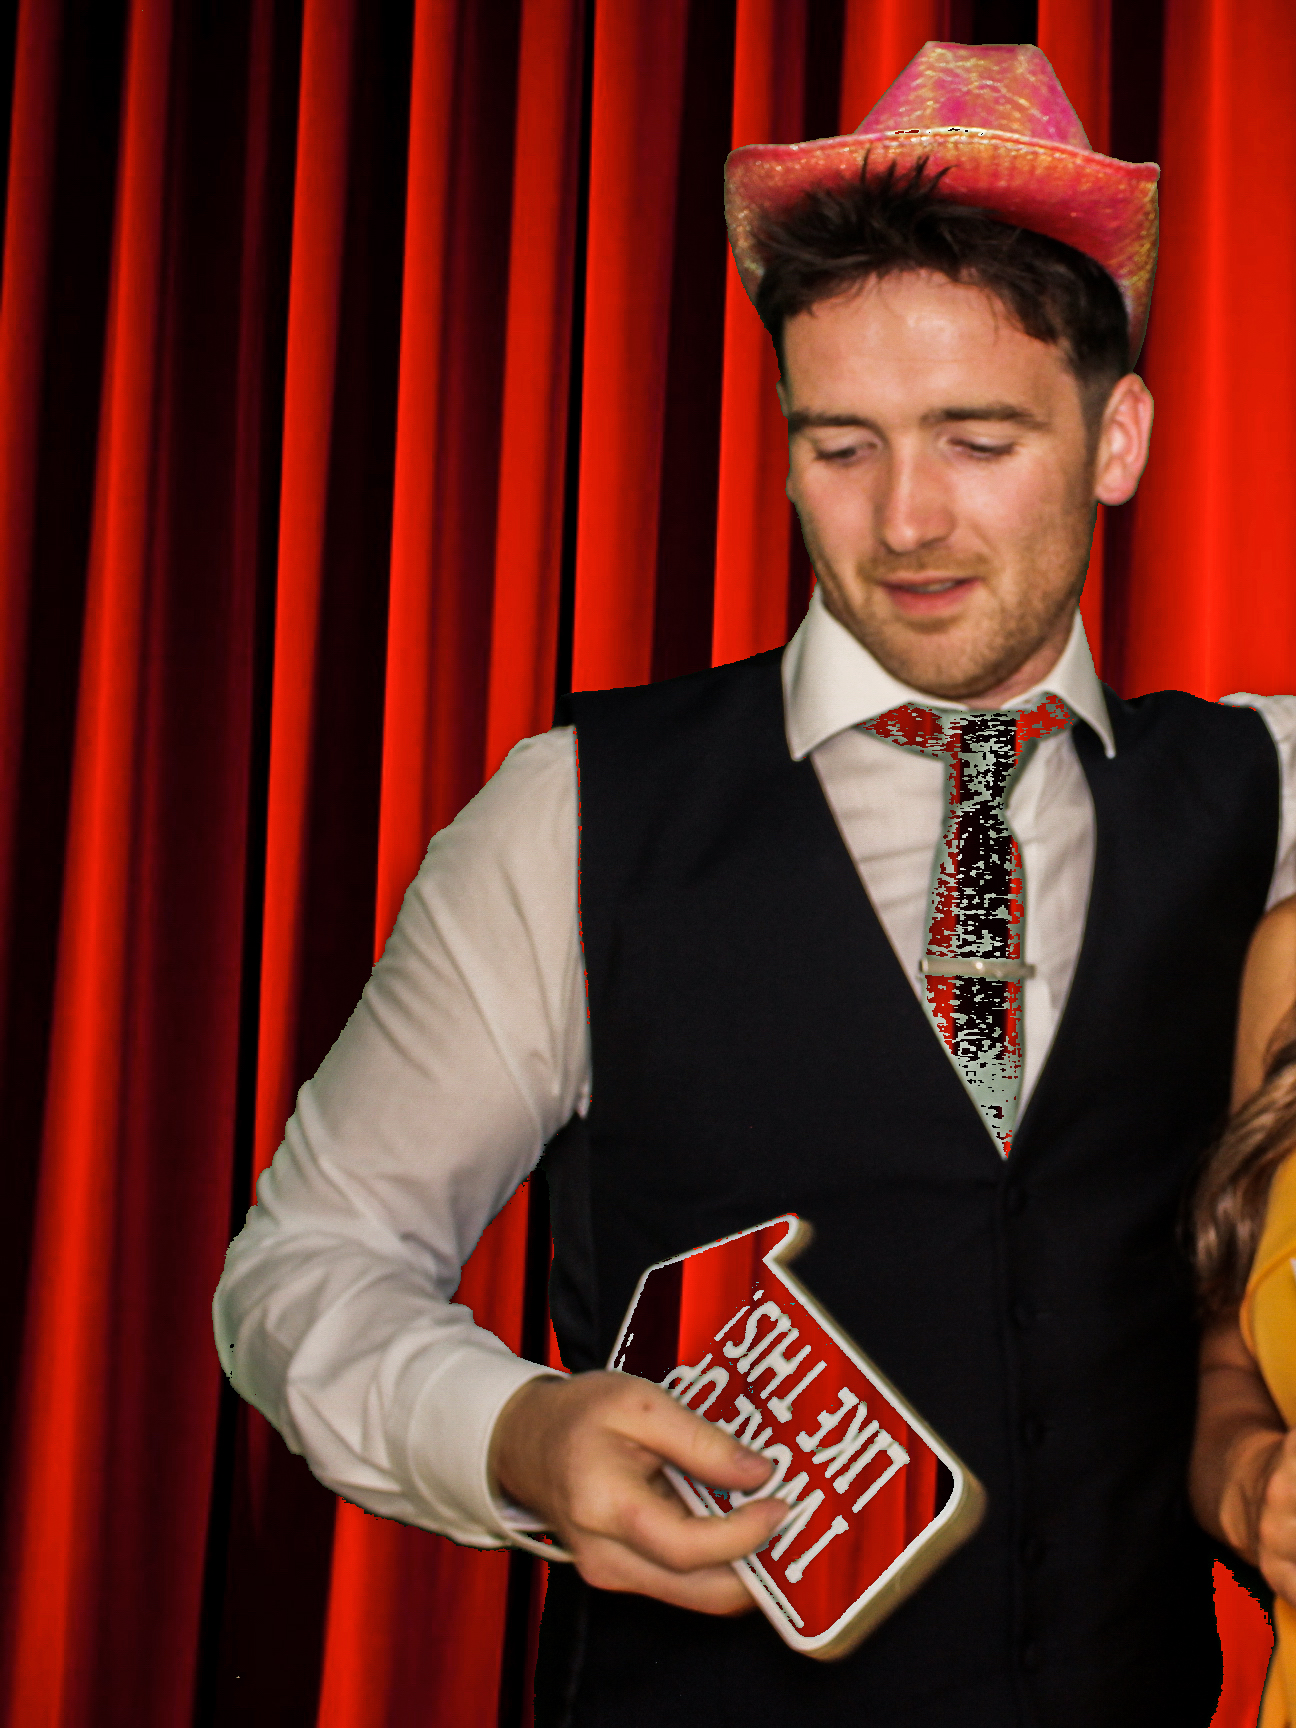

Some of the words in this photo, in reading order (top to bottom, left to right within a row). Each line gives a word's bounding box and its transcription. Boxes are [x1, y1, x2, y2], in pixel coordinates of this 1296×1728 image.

[713, 1289, 828, 1424] THIS!
[795, 1386, 911, 1514] LIKE
[784, 1514, 849, 1584] I
